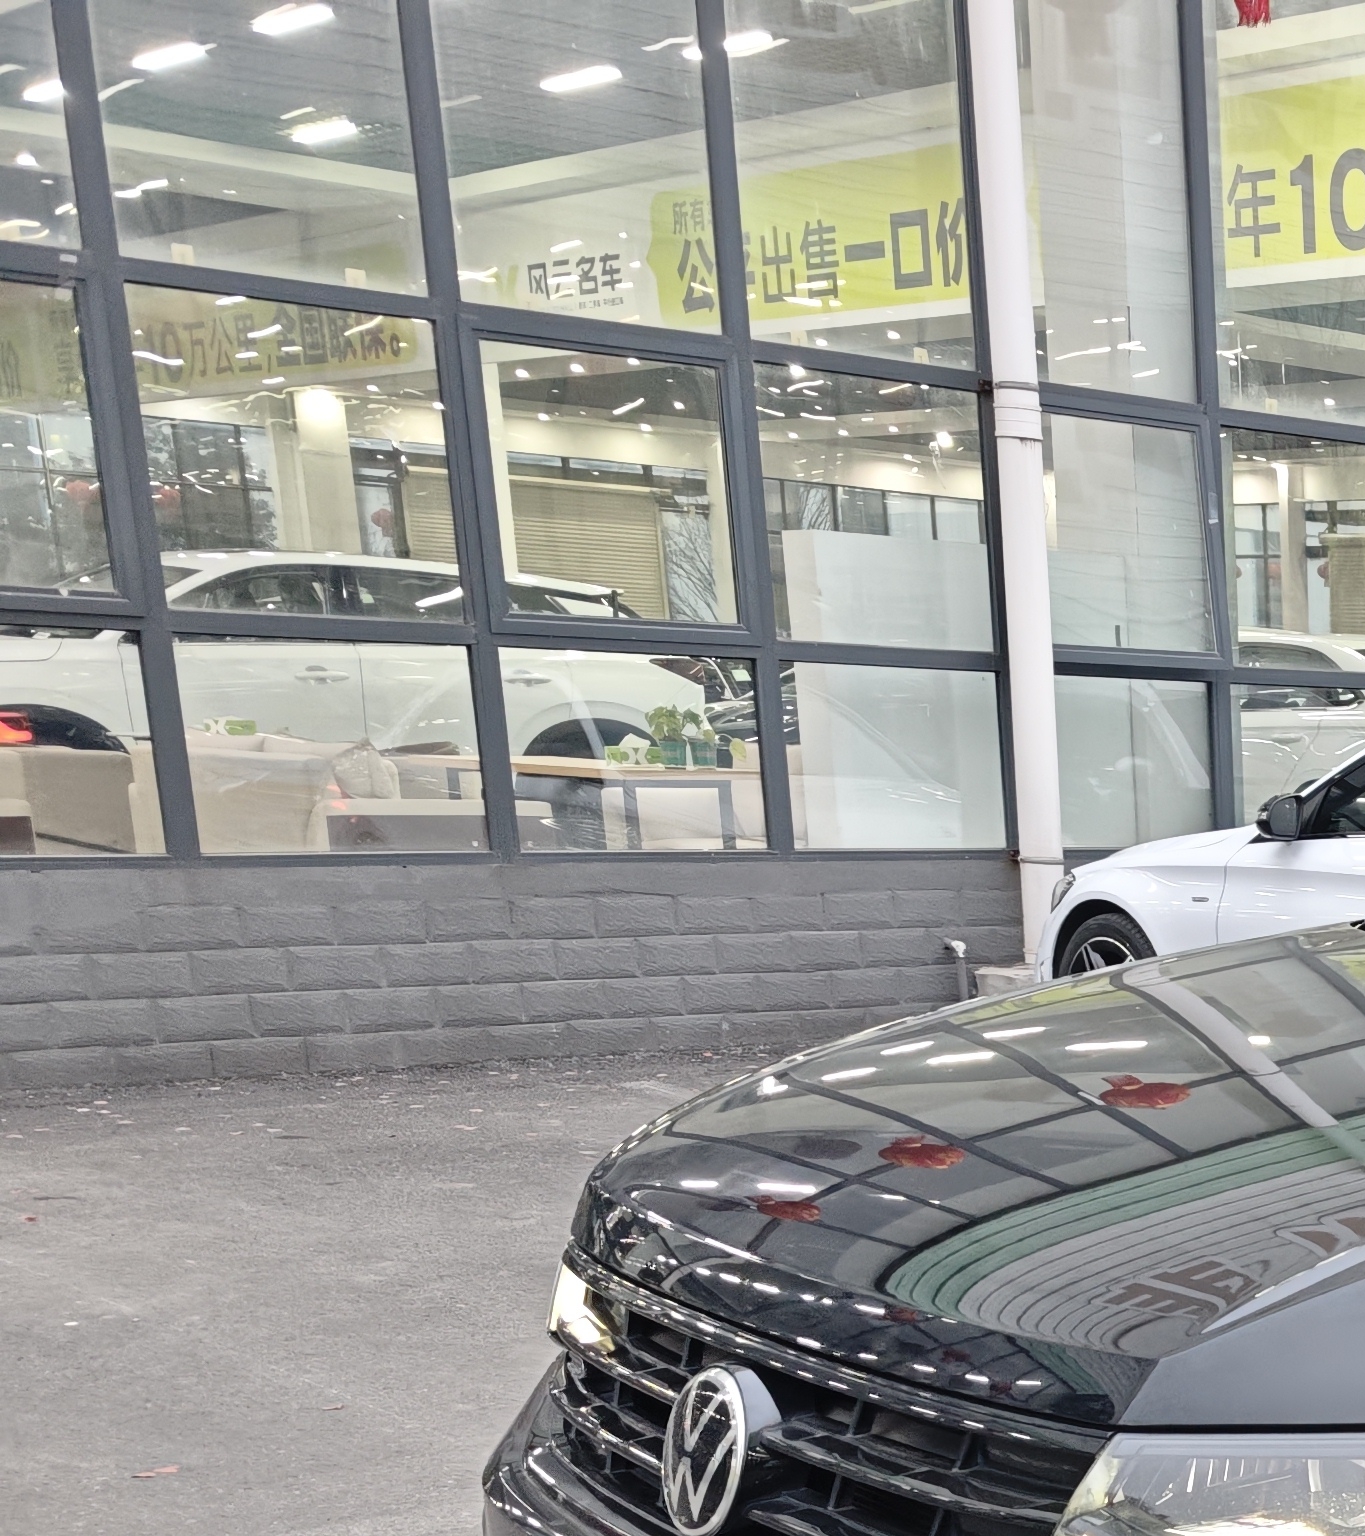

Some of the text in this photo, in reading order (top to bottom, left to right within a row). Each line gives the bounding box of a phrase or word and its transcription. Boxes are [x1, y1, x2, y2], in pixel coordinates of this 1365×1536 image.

[677, 197, 966, 314] 公出售一口价
